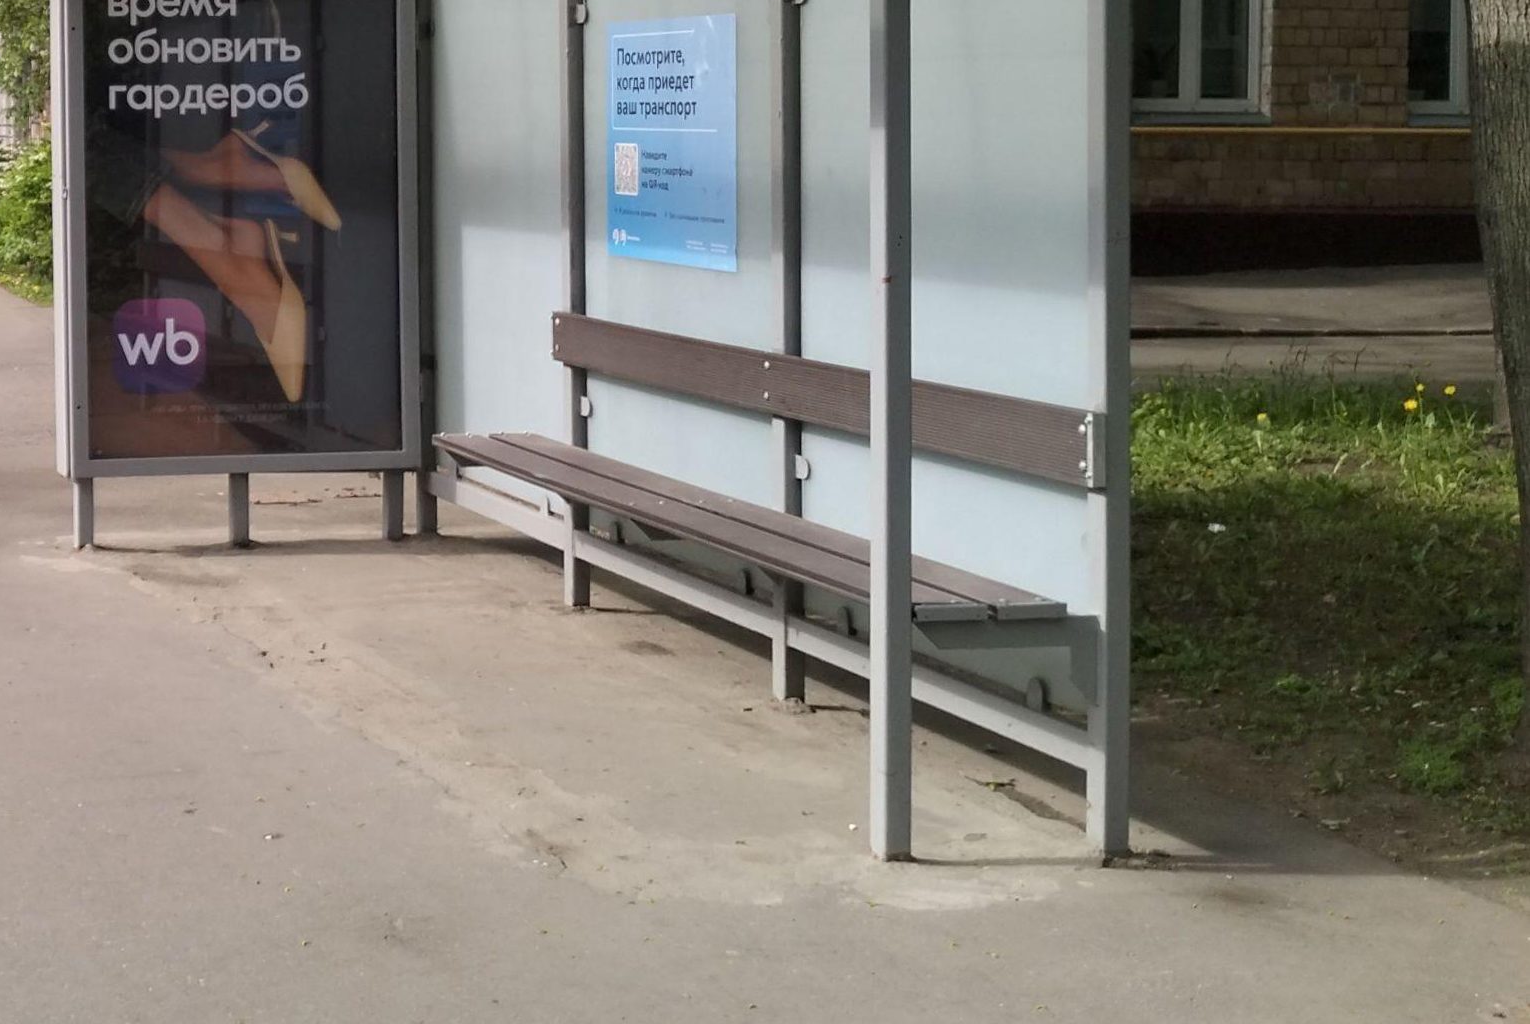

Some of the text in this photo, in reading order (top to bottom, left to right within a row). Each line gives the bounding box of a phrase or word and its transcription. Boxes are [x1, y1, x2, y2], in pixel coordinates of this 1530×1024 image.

[108, 27, 302, 64] обновить
[616, 48, 685, 69] Посмотрите,
[108, 72, 309, 117] гардероб
[616, 75, 695, 94] когда приедет
[616, 101, 697, 120] ваш транспорт
[118, 318, 200, 366] wb
